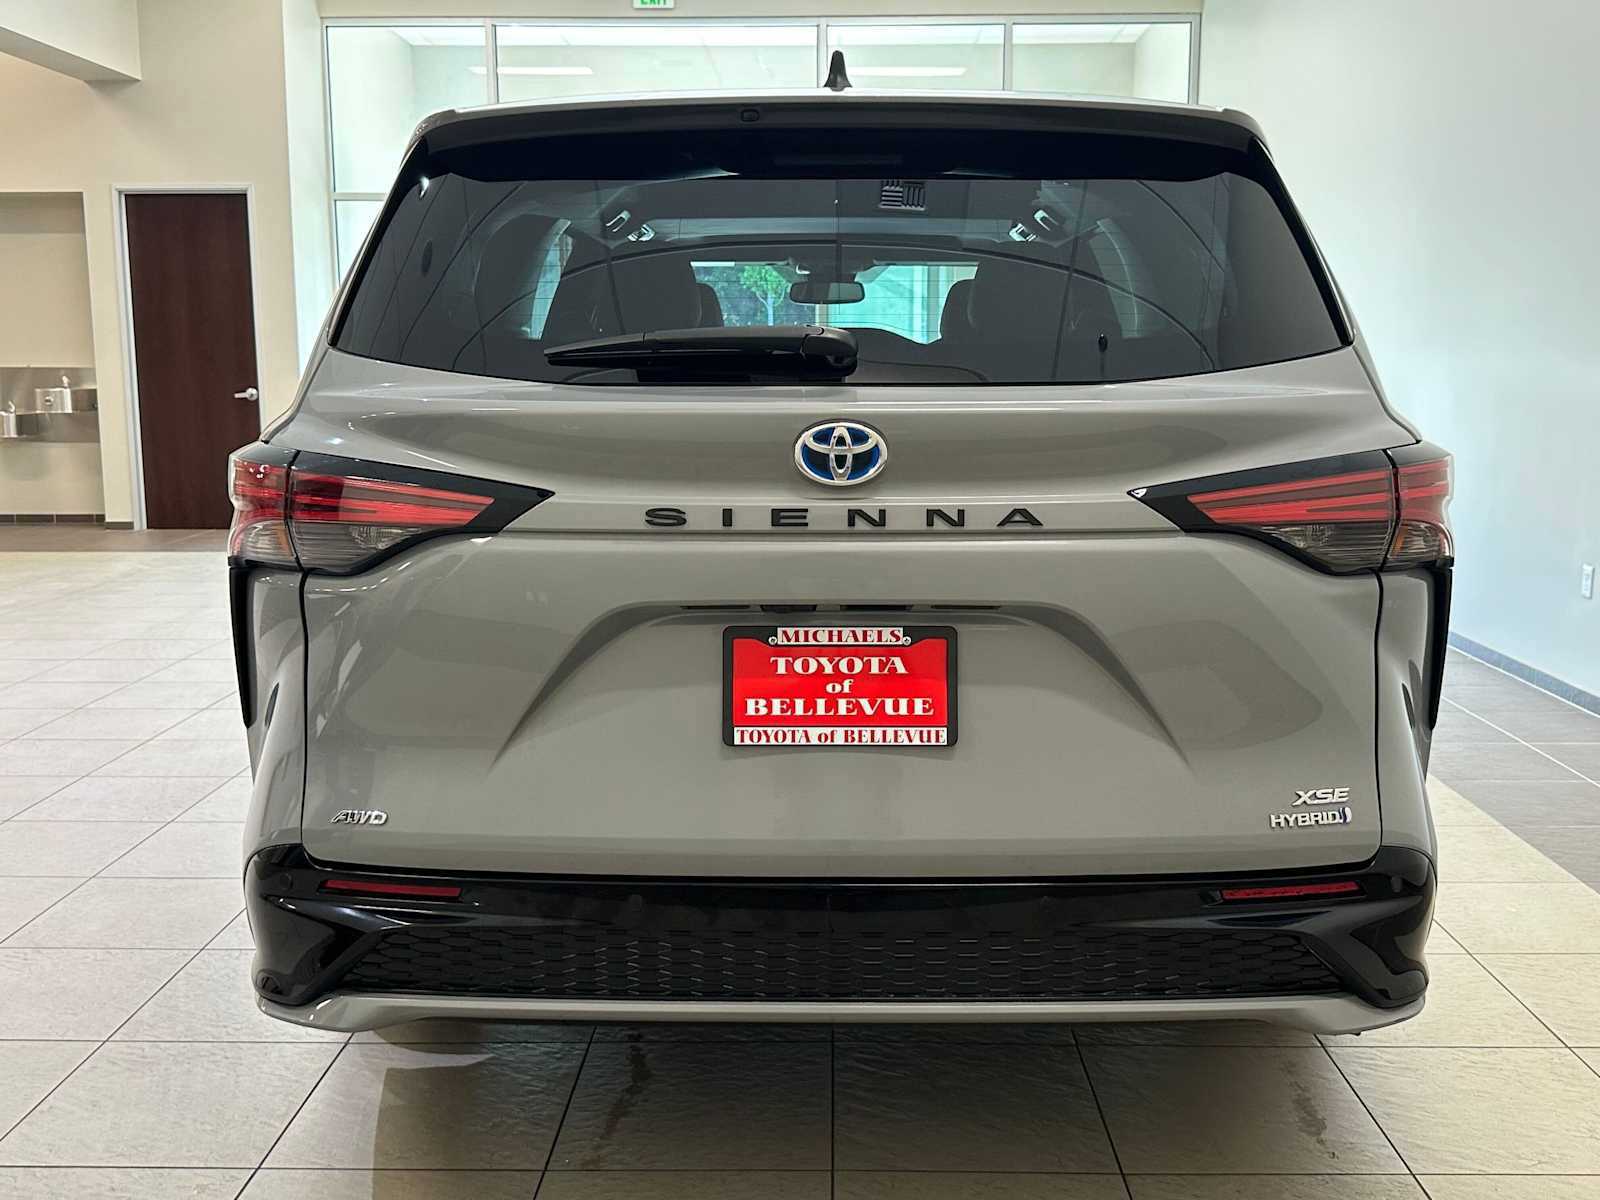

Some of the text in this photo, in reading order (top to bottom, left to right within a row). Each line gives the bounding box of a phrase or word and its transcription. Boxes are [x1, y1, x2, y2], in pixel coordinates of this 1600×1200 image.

[645, 507, 1043, 528] SIENNA
[781, 629, 901, 643] MICHAELS
[769, 656, 909, 675] TOYOTA
[825, 679, 854, 694] of
[744, 697, 934, 717] BELLEVUE
[736, 729, 946, 744] TOYOTA of BELLEVUE
[1291, 787, 1350, 806] XSE
[331, 809, 388, 825] AWD
[1270, 810, 1341, 828] HYBRID
